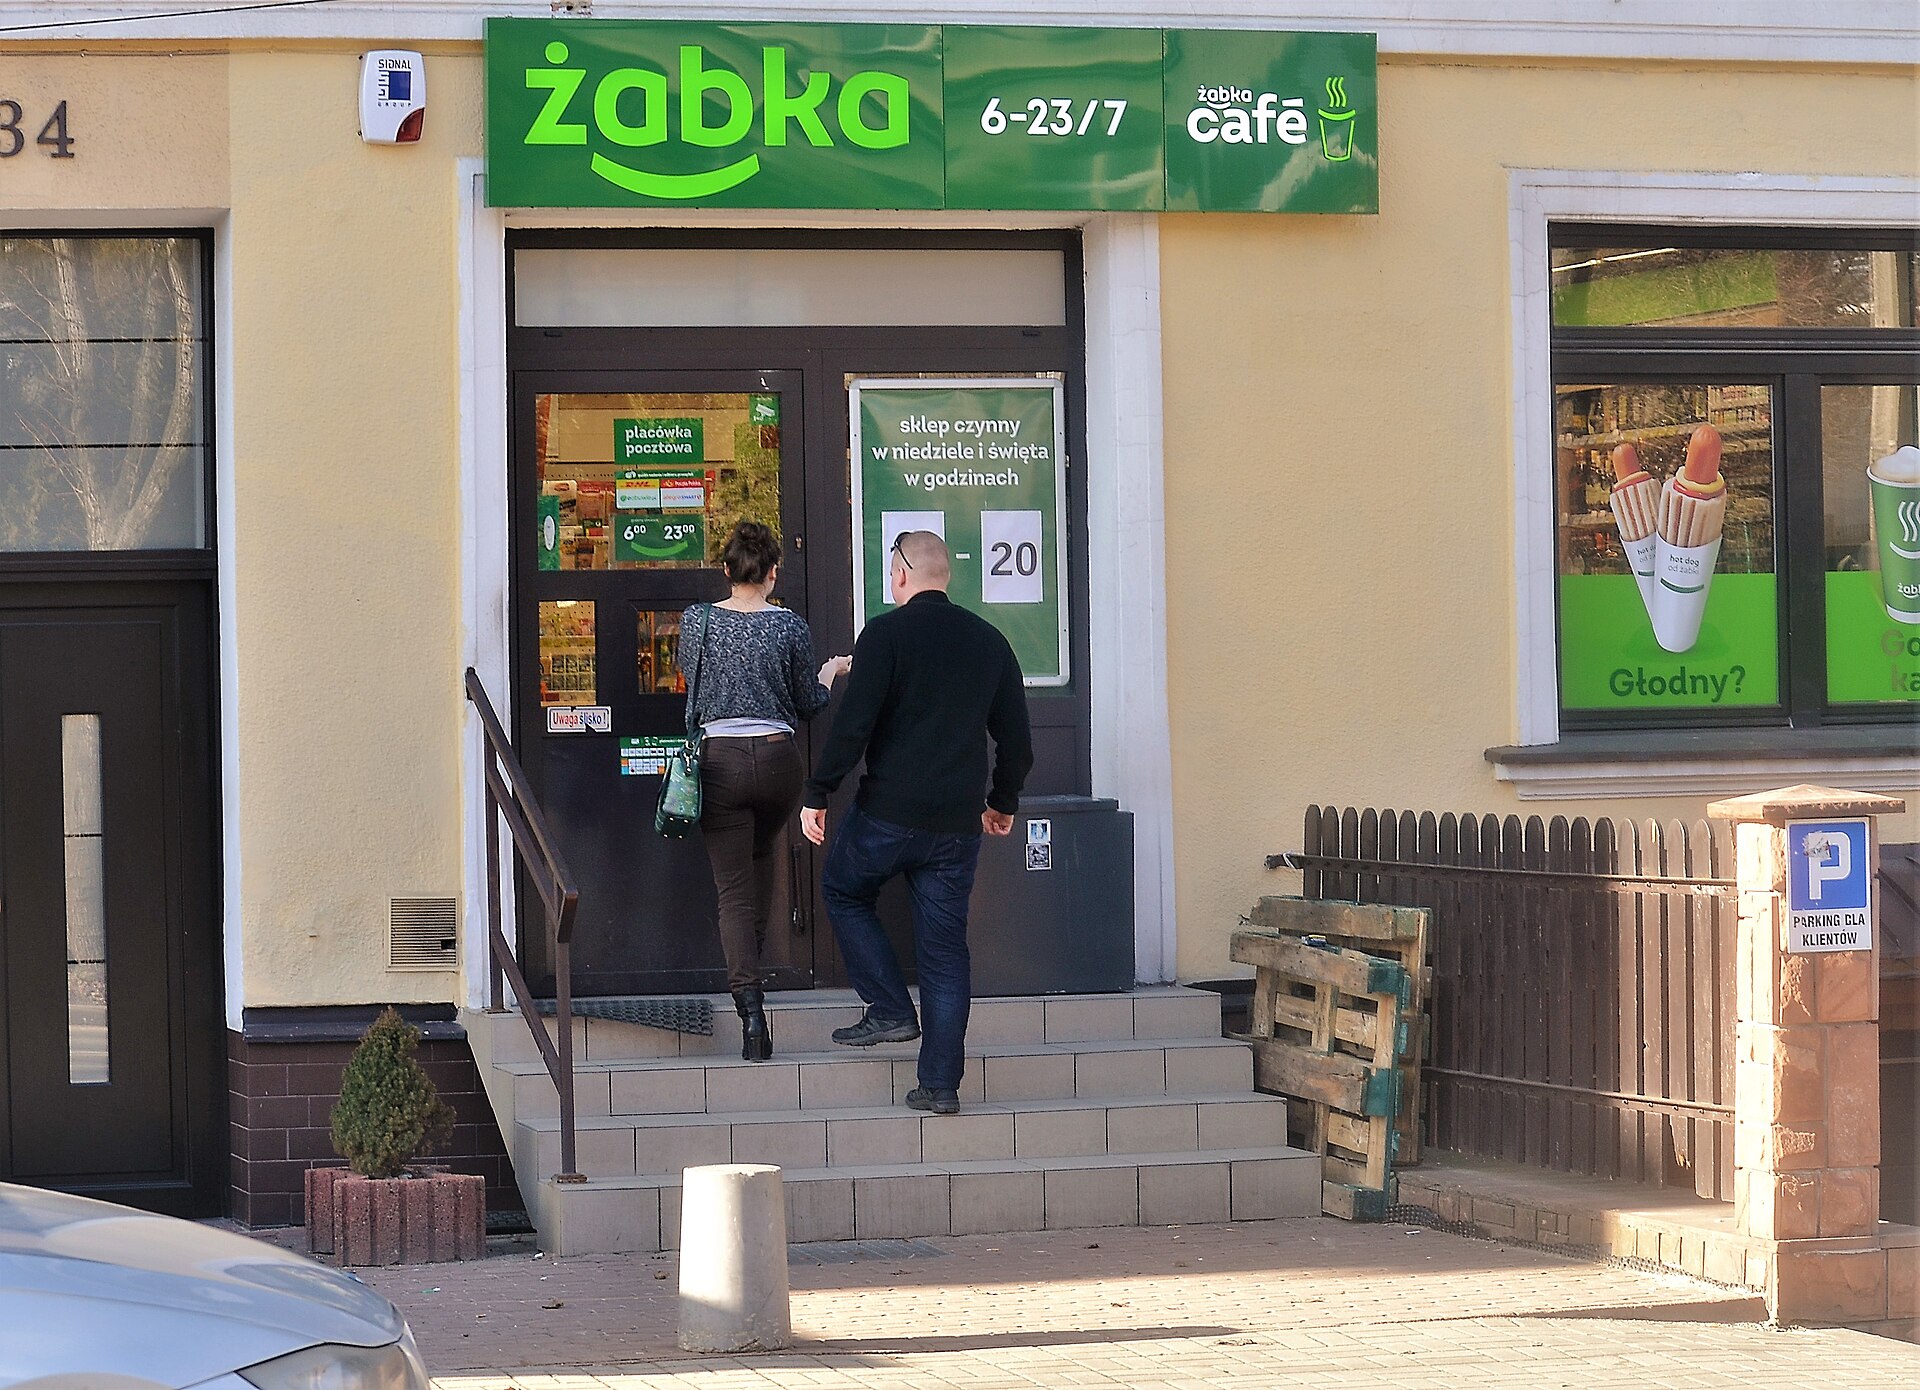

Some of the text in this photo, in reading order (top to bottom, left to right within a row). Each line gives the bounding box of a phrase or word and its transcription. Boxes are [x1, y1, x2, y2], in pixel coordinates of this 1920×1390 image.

[523, 41, 911, 149] żabka
[1197, 84, 1253, 103] żabka
[980, 96, 1128, 136] 6-23/7
[625, 425, 693, 442] placówka
[900, 415, 1021, 438] sklep czynny
[625, 442, 693, 458] pocztowa
[872, 442, 1049, 464] w niedziele i święta
[904, 468, 1019, 491] w godzinach
[990, 541, 1038, 576] 20
[1669, 554, 1700, 568] hot dog
[1609, 664, 1746, 703] Głodny?
[553, 712, 578, 727] Uwaga
[579, 712, 602, 725] ślisko
[1808, 831, 1852, 900] P
[1793, 914, 1841, 928] PARKING
[1802, 929, 1858, 947] KLIENTÓW
